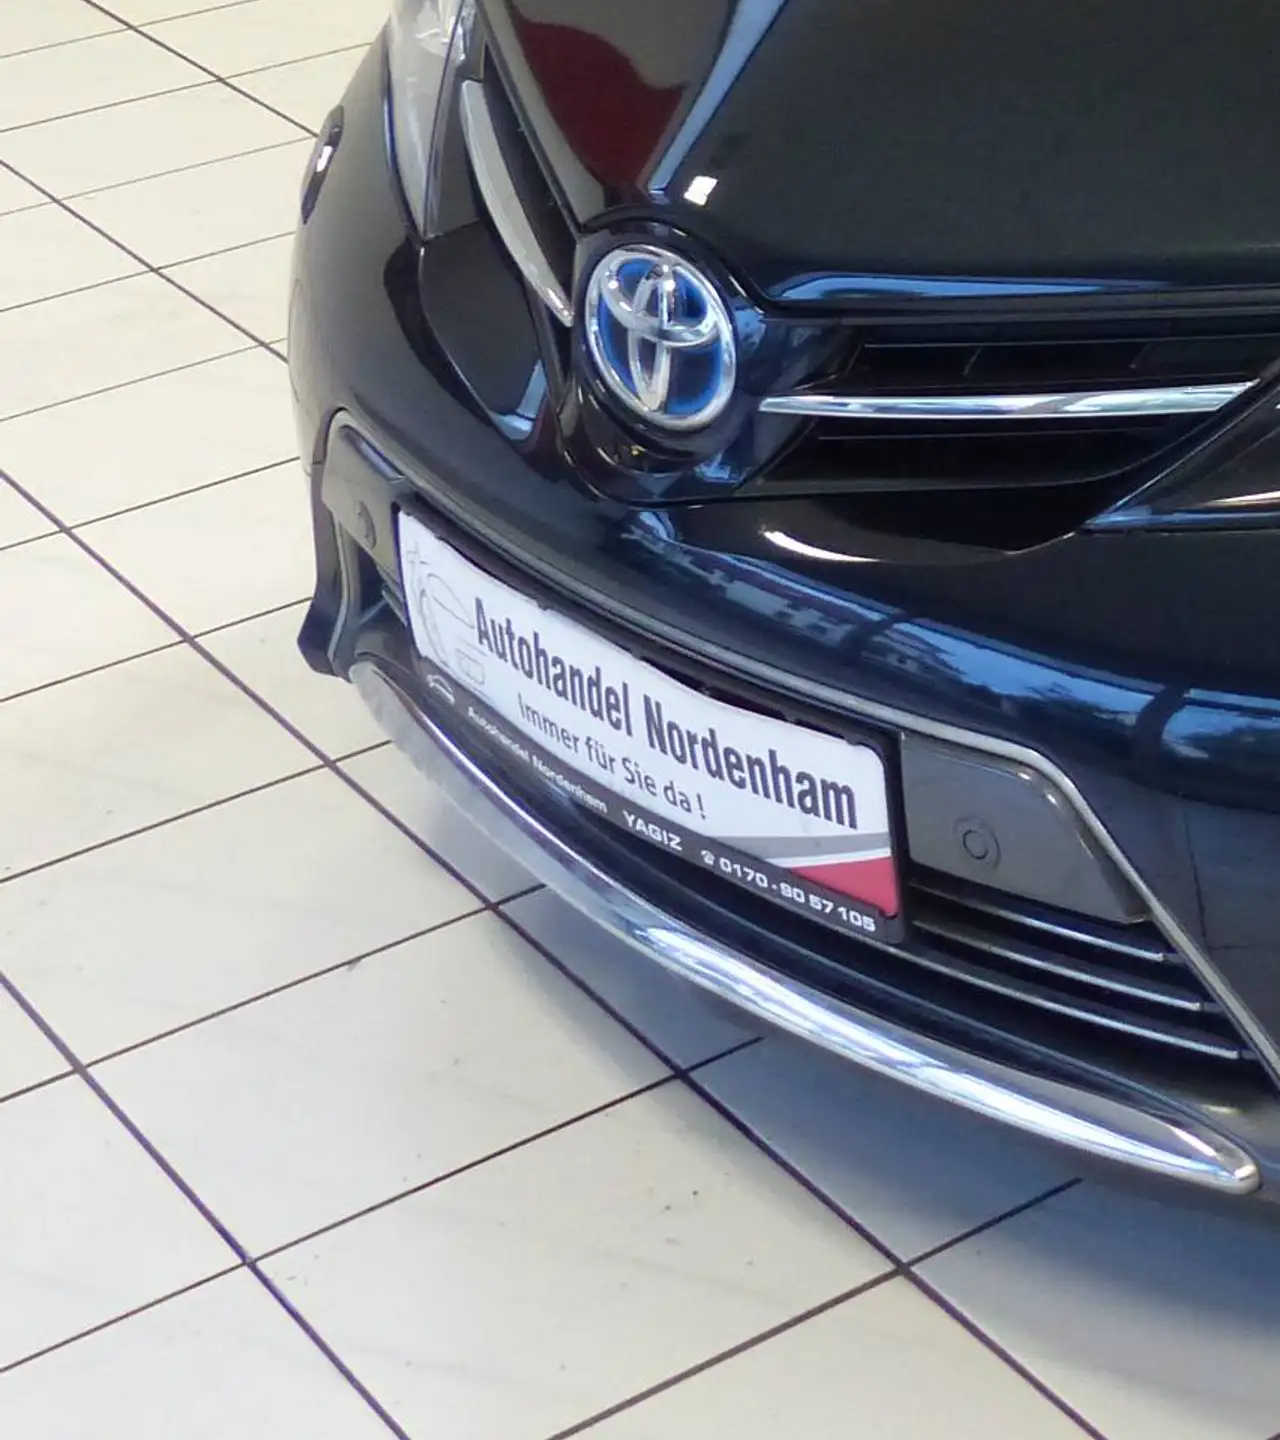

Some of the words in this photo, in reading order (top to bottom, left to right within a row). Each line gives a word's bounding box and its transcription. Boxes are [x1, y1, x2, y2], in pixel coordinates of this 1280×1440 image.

[474, 596, 634, 737] Autohandel
[643, 694, 858, 830] Nordenham
[517, 692, 581, 754] Immer
[585, 734, 617, 775] für
[621, 756, 658, 797] Sie
